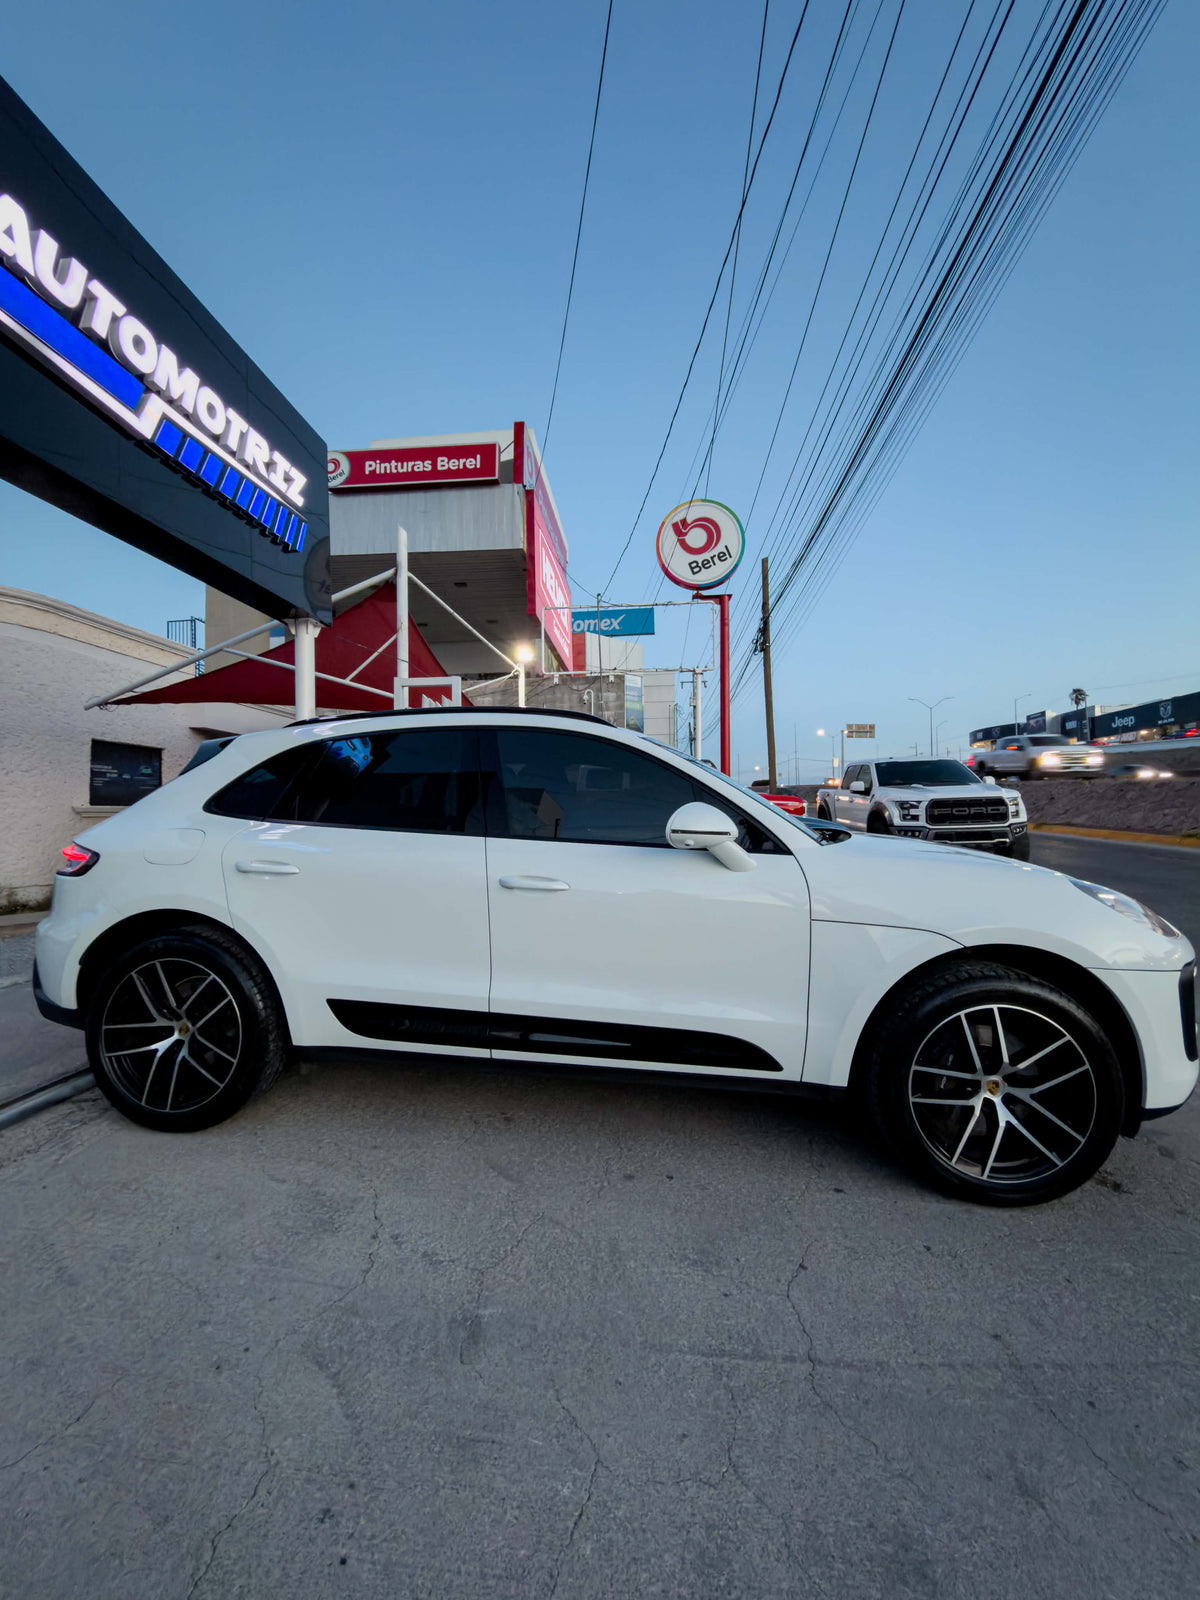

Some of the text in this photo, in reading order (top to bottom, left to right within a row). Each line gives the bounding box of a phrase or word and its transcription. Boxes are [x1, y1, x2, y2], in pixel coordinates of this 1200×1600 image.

[0, 194, 309, 508] AUTOMOTRIZ
[364, 453, 481, 475] Pinturas Berel
[687, 544, 733, 576] Berel
[571, 613, 626, 633] omex
[1111, 715, 1135, 728] Jeep
[934, 805, 1007, 815] FORD
